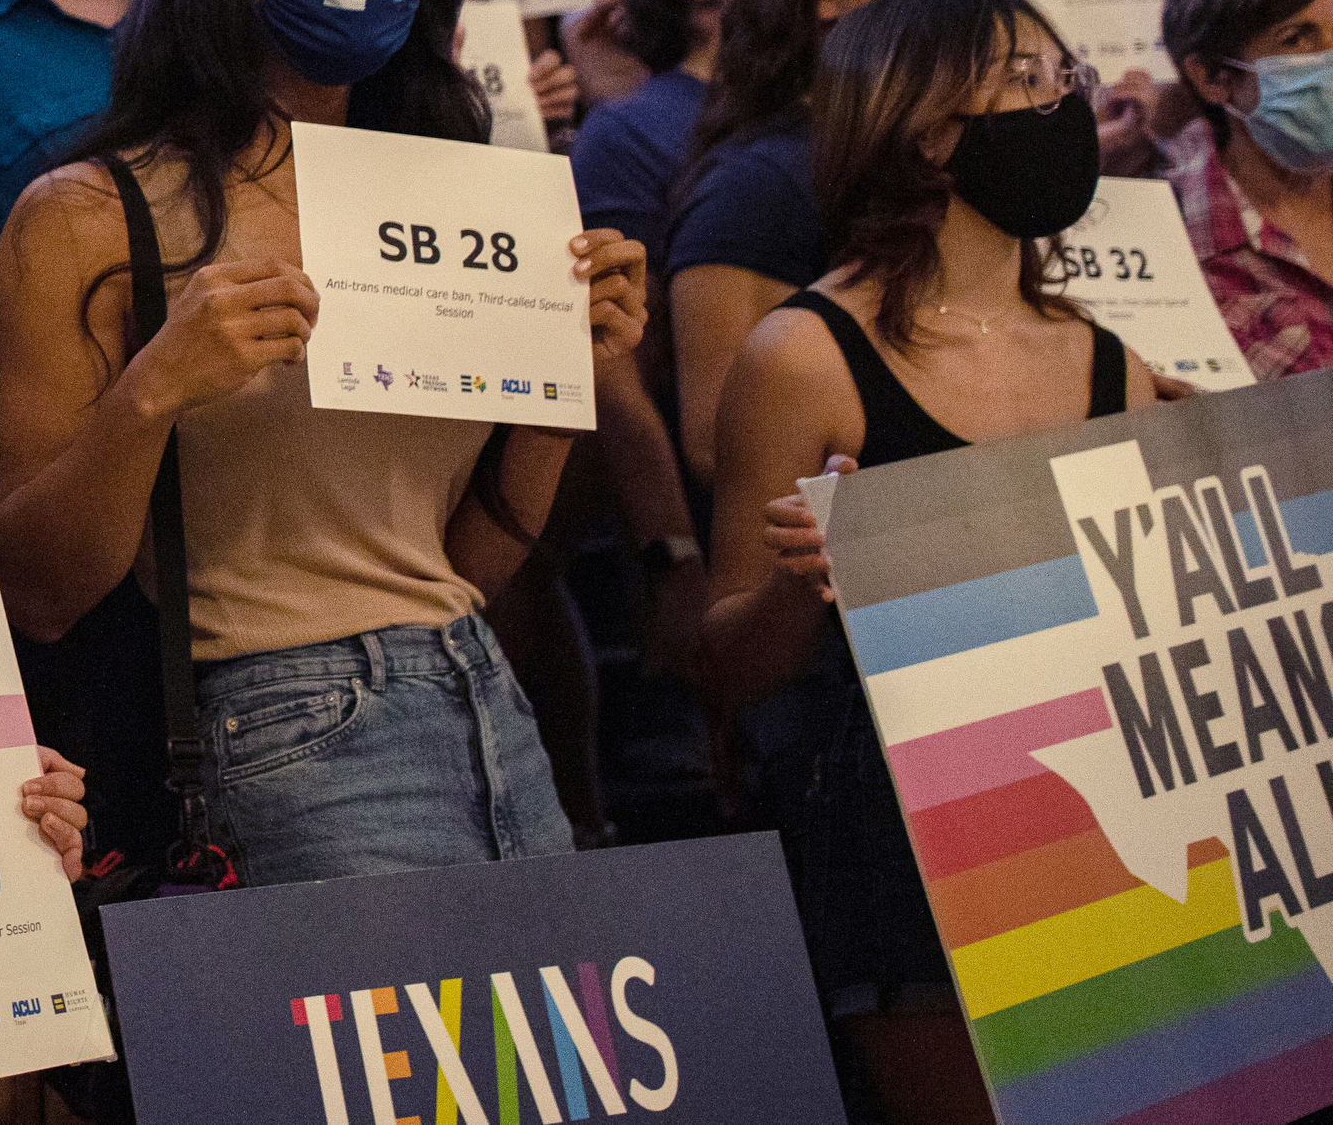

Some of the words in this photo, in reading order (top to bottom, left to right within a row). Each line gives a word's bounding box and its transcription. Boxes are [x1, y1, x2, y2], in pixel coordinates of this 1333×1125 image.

[378, 221, 441, 265] SB
[460, 229, 519, 273] 28
[1064, 245, 1102, 280] SB
[1109, 246, 1154, 282] 32
[325, 278, 379, 294] Anti-trans
[382, 284, 423, 297] medical
[426, 289, 448, 300] care
[452, 290, 474, 304] ban,
[478, 292, 536, 309] Third-called
[539, 298, 574, 313] Special
[435, 305, 474, 319] Session
[501, 378, 531, 395] ACLU
[1077, 475, 1323, 640] Y'ALL
[1102, 601, 1333, 799] MEAN
[1226, 760, 1333, 932] AL
[6, 921, 42, 936] Session
[12, 997, 41, 1018] ACLU
[290, 955, 679, 1125] TEXANS
